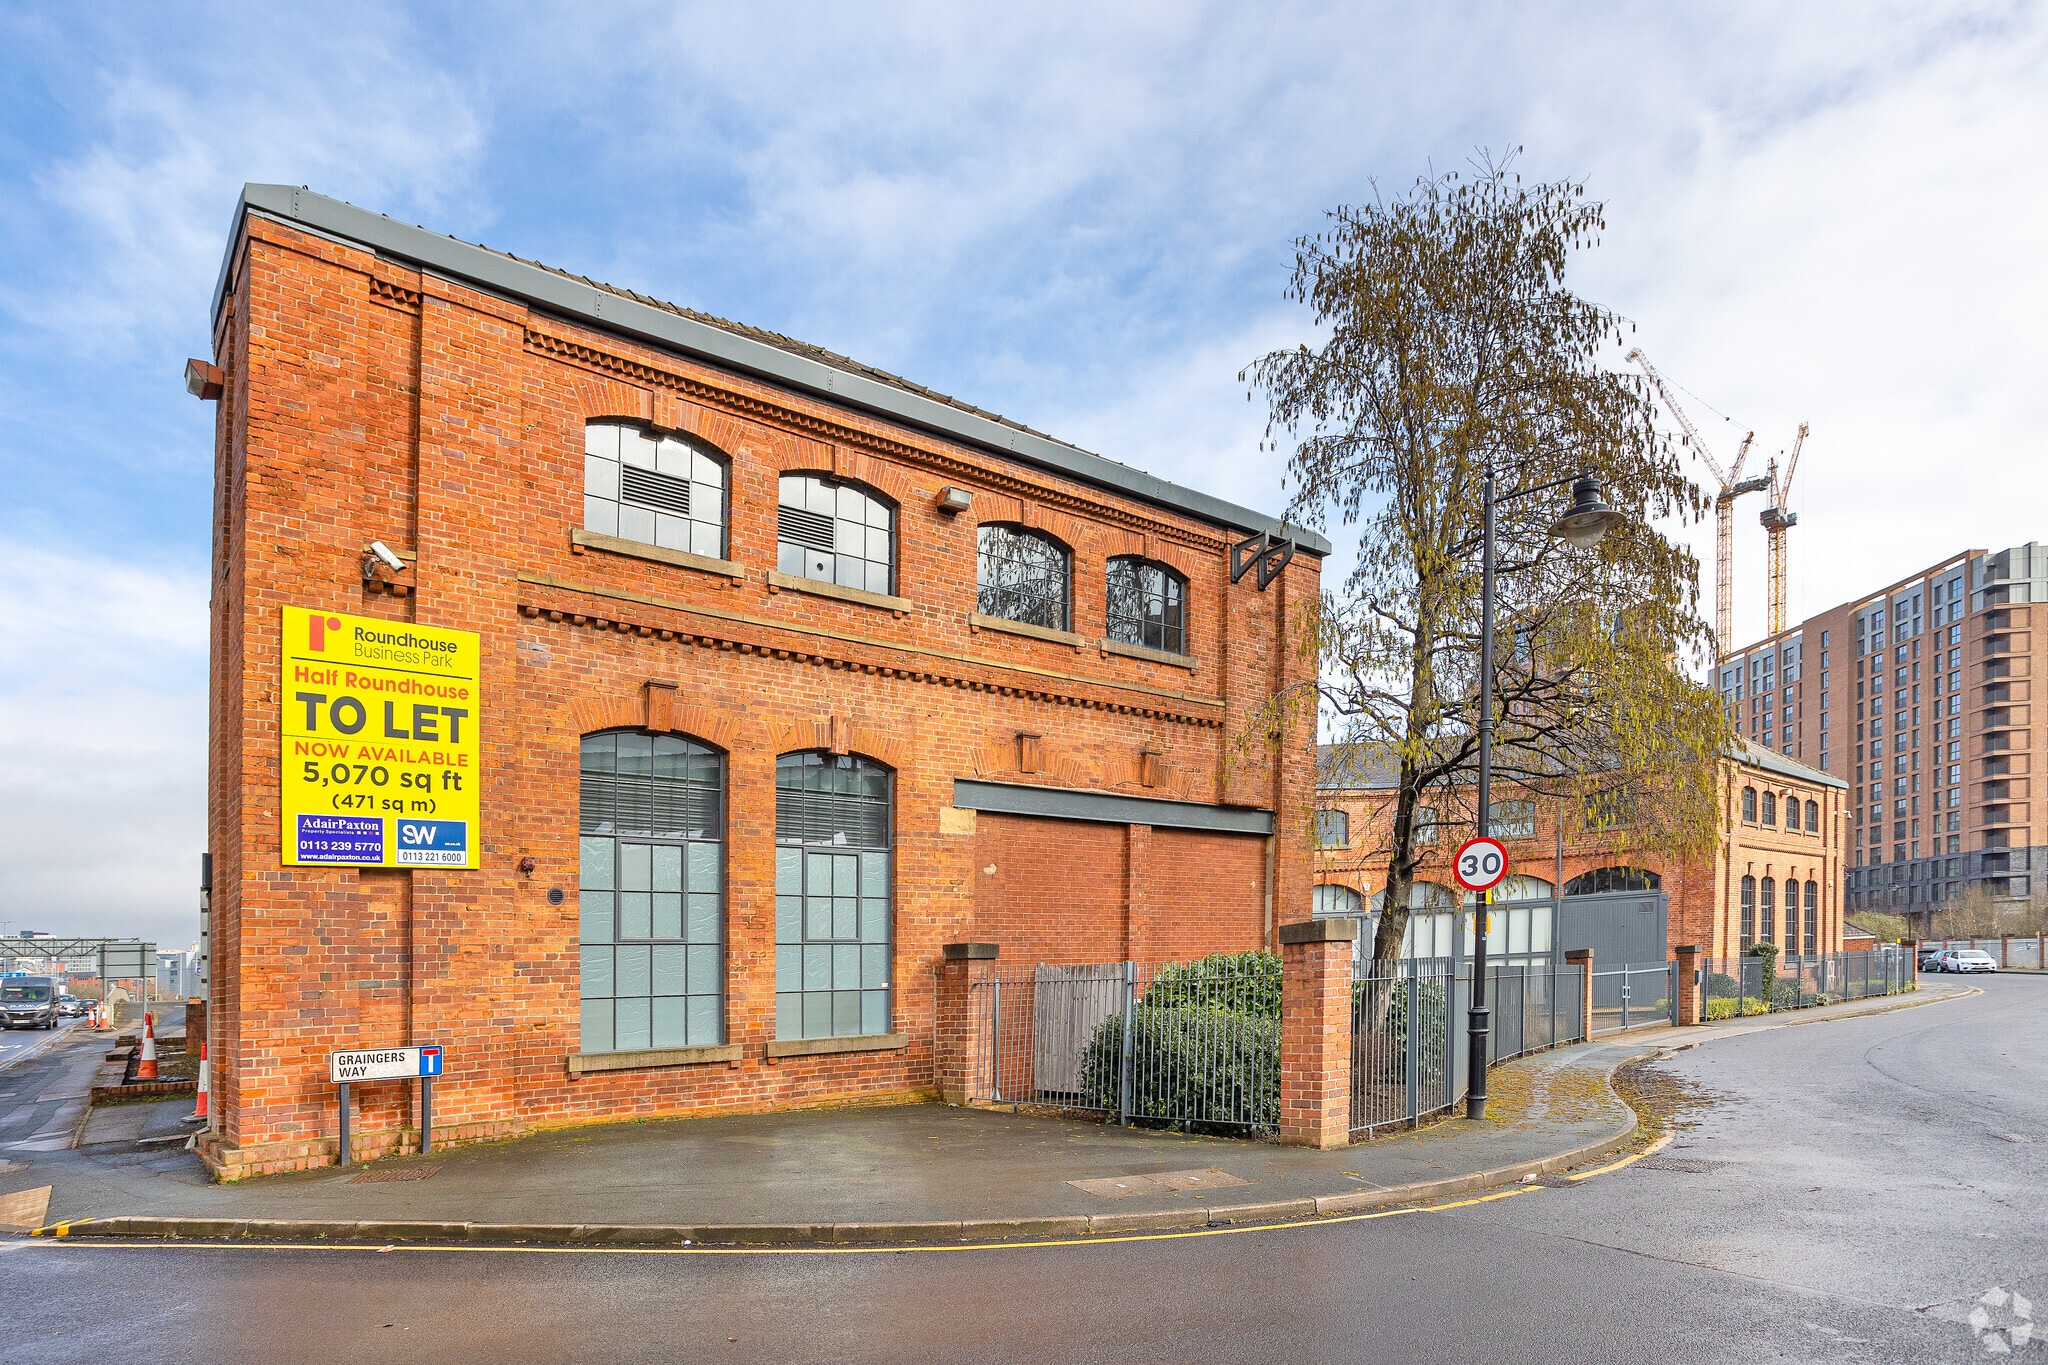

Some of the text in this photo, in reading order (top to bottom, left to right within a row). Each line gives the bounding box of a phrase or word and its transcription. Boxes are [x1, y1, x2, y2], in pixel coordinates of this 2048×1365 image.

[354, 626, 458, 653] Roundhouse
[354, 642, 453, 668] Business Park
[294, 665, 469, 700] Half Roundhouse
[296, 691, 468, 744] TO LET
[294, 741, 468, 767] NOW AVAILABLE
[303, 761, 462, 793] 5,070 sq ft
[332, 793, 436, 814] (471 sq m)
[302, 818, 379, 831] AdairPaxton
[402, 824, 437, 845] SW
[300, 840, 381, 851] 0113 239 5770
[300, 853, 381, 861] www.adairpaxton.co.uk
[402, 851, 462, 862] 0113 221 6000
[1461, 852, 1501, 877] 30
[338, 1052, 406, 1066] GRAINGERS
[338, 1066, 367, 1078] WAY
